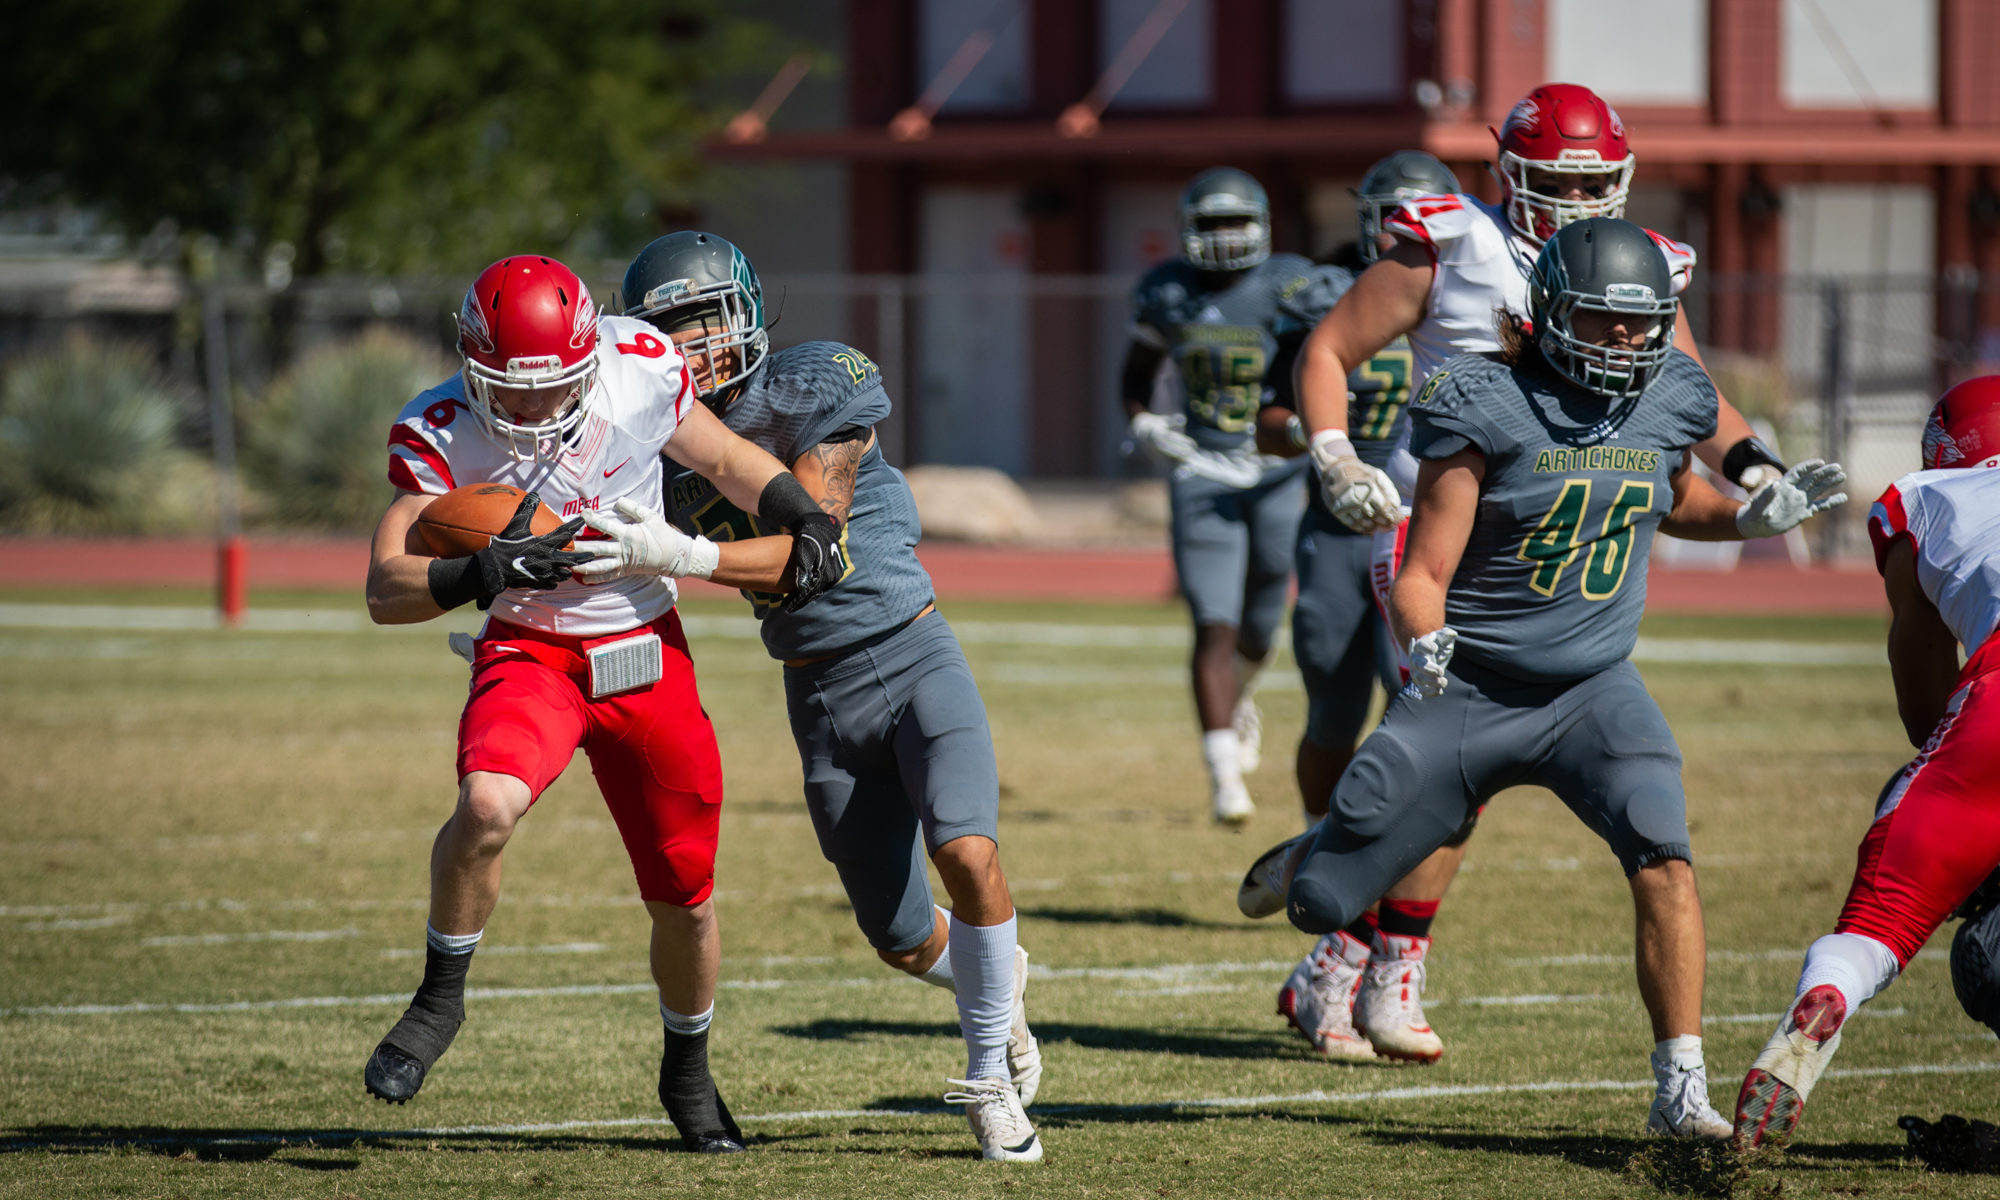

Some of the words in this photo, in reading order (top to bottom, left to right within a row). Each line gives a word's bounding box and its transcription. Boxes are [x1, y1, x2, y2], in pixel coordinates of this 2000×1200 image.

[614, 332, 667, 359] 6
[518, 359, 550, 370] Riddell
[832, 347, 877, 385] 24
[422, 397, 471, 429] 6
[1533, 445, 1661, 473] ARTICHOKES
[1516, 478, 1655, 601] 46
